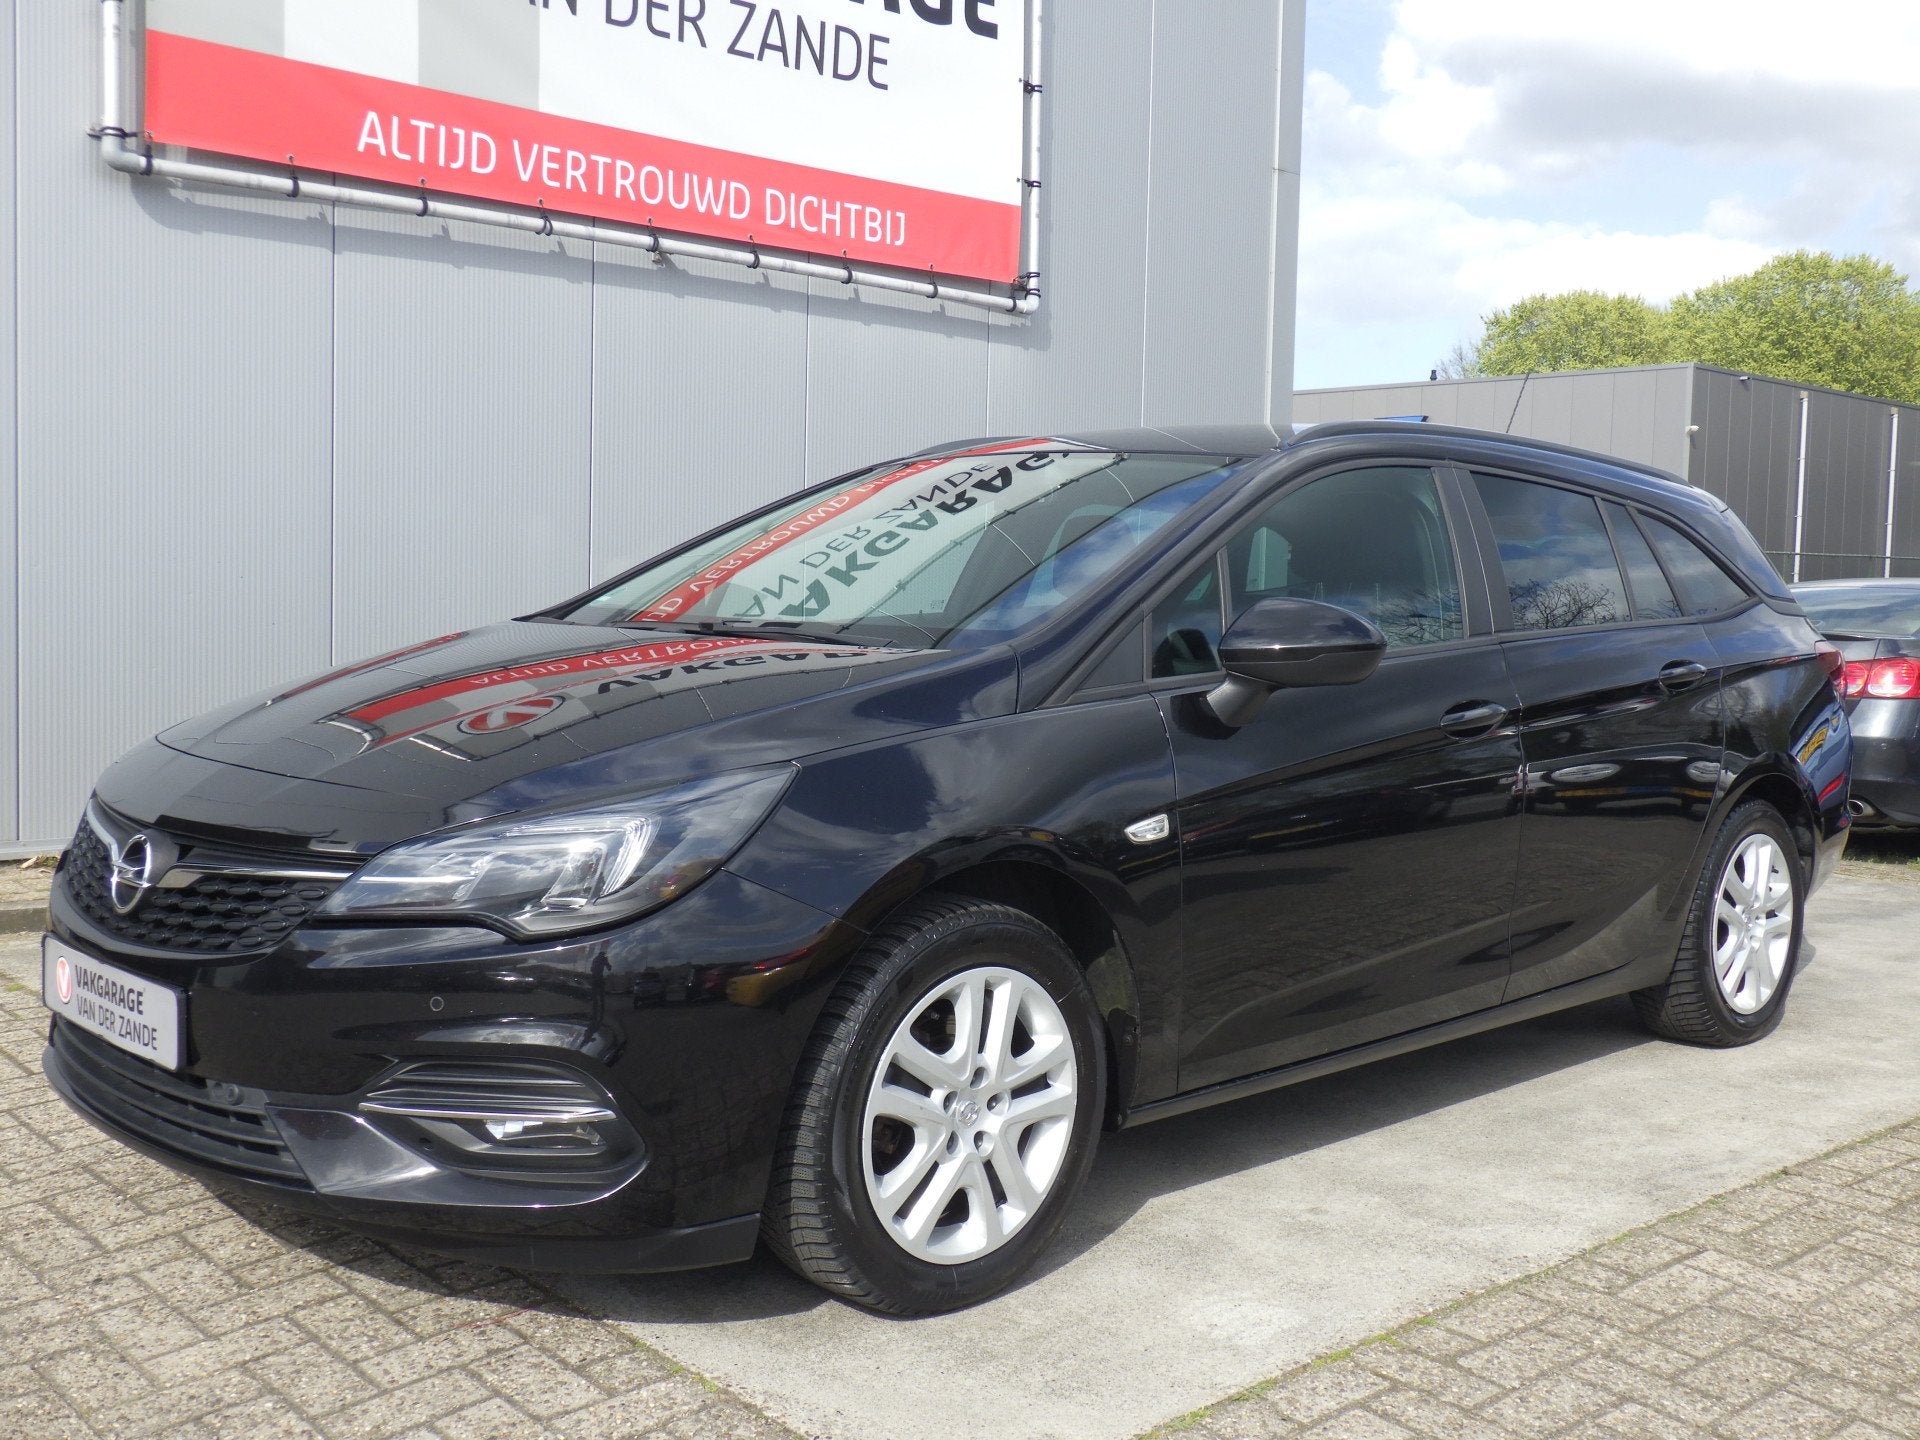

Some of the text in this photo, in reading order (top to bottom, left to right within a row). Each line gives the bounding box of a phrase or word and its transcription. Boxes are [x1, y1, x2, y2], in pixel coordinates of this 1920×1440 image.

[727, 0, 890, 90] ZANDE
[357, 111, 906, 246] ALTIJD VERTROUWD DICHTBIJ
[75, 965, 144, 1015] VAKGARAGE
[76, 994, 158, 1051] VAN DER ZANDE
